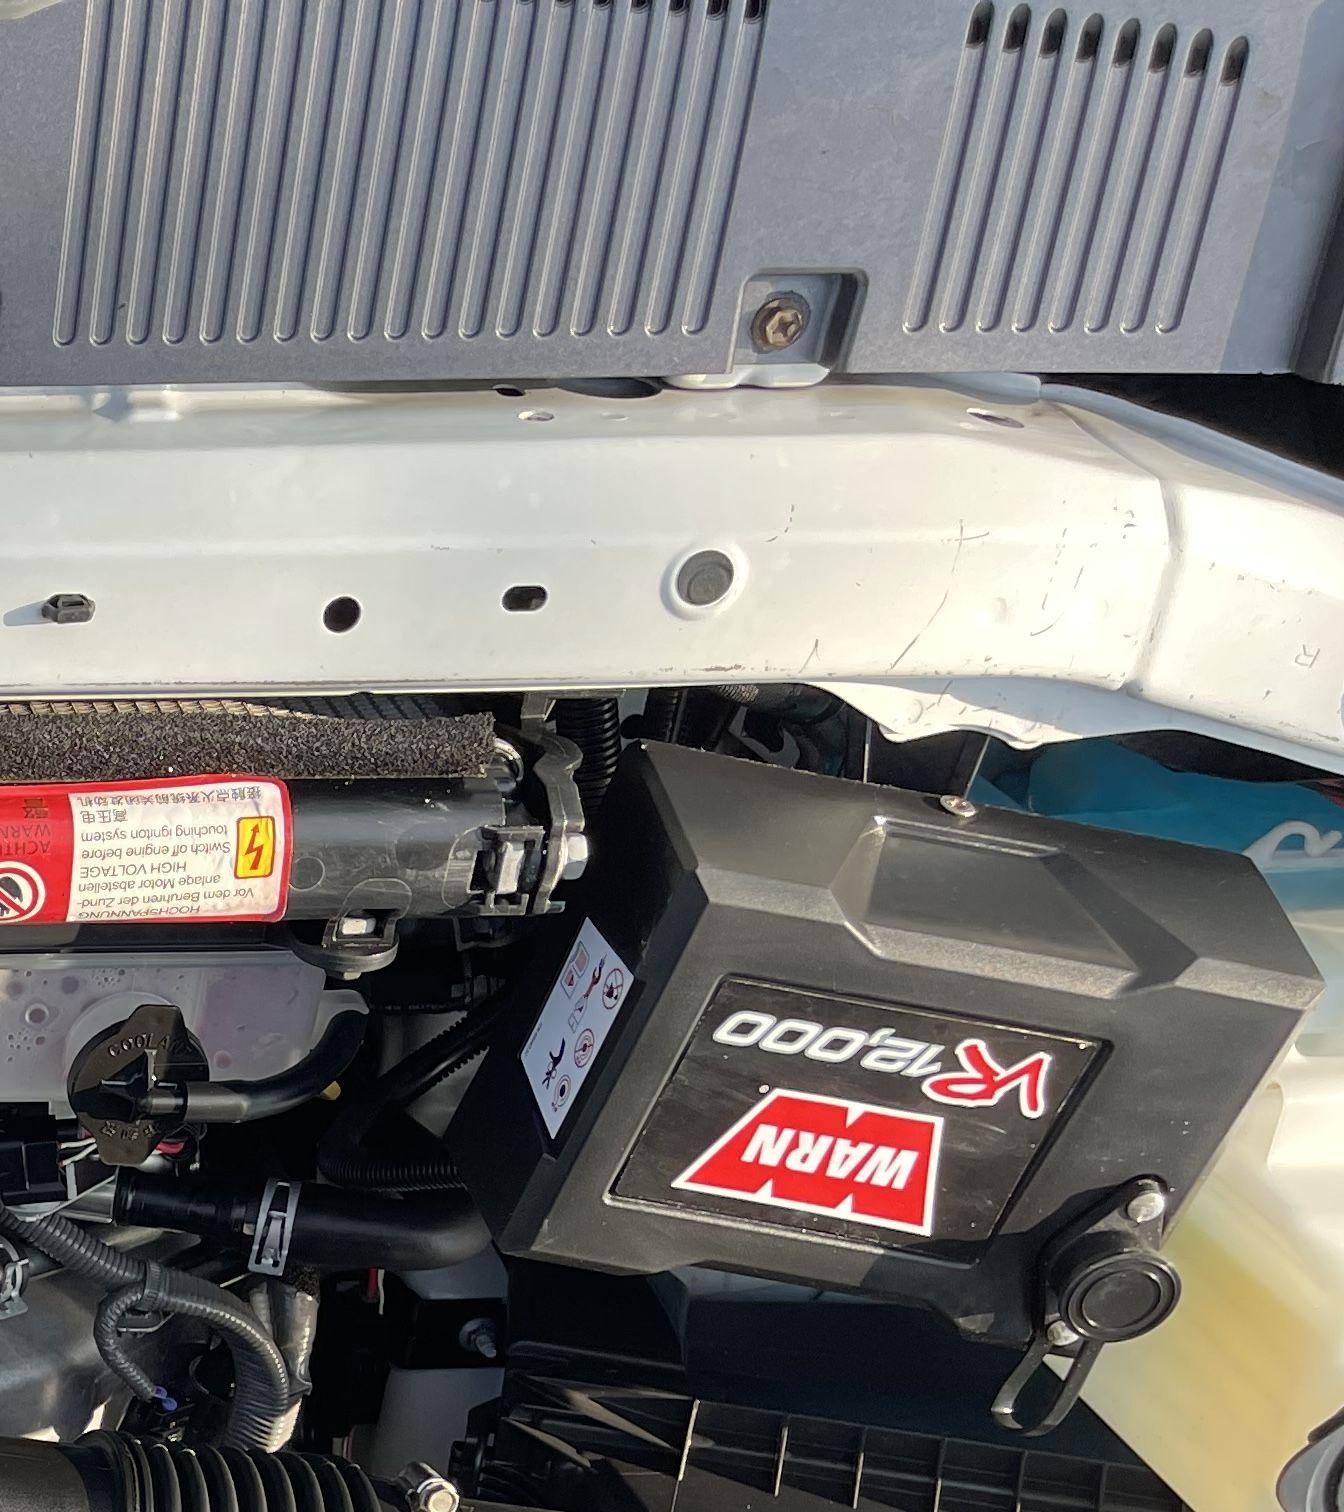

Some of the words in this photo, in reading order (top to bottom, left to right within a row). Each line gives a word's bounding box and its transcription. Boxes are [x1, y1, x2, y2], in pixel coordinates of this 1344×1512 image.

[79, 808, 128, 824] 高压电
[80, 828, 128, 842] system
[175, 822, 228, 838] touching
[81, 848, 123, 861] before
[125, 842, 169, 858] engine
[170, 845, 188, 857] off
[190, 842, 231, 855] Switch
[79, 863, 147, 878] VOLTAGE
[150, 861, 187, 873] HIGH
[78, 880, 136, 893] abstellen
[138, 877, 175, 889] Motor
[203, 889, 231, 900] dem
[233, 887, 254, 898] Vor
[119, 896, 139, 907] der
[77, 904, 201, 919] HOCHSPANNUNG
[712, 1010, 946, 1077] 12,000
[740, 1123, 919, 1190] WARN
